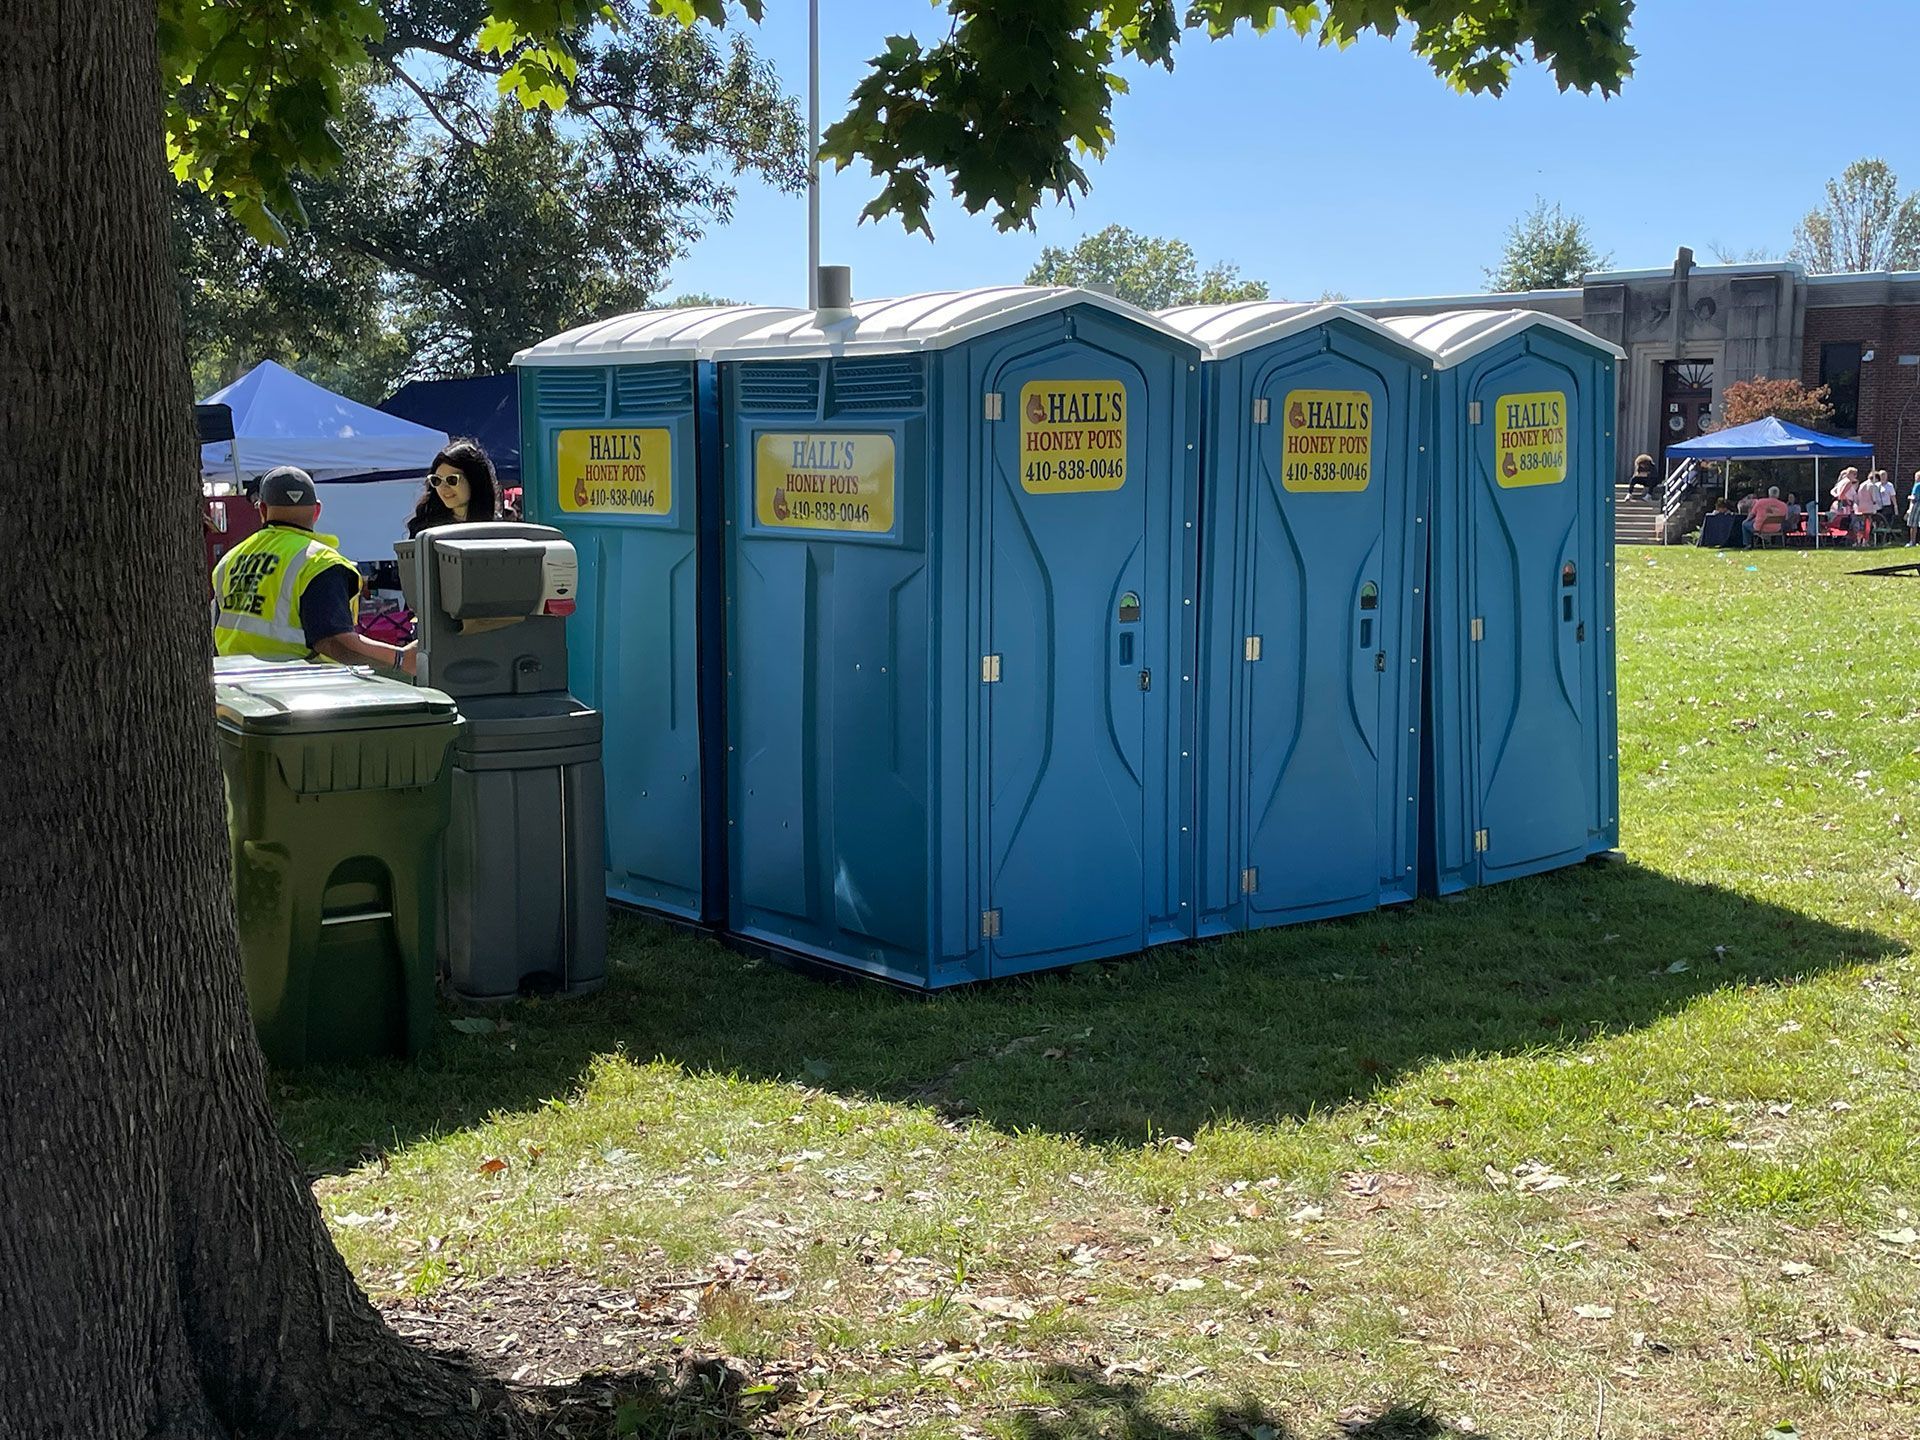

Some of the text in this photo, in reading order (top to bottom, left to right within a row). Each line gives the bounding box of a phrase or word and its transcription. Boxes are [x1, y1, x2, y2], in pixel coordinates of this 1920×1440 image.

[1048, 393, 1122, 423] HALL'S
[1307, 402, 1368, 429] HALL'S
[1507, 402, 1559, 429] HALL'S
[590, 435, 641, 460] HALL'S
[1026, 430, 1122, 451] HONEY POTS
[1288, 436, 1367, 454] HONEY POTS
[1502, 427, 1563, 448] HONEY POTS
[792, 441, 855, 470] HALL'S
[1520, 451, 1563, 470] 838-0046
[585, 465, 646, 481] HONEY POTS
[1025, 459, 1123, 481] 410-838-0046
[1287, 463, 1367, 480] 410-838-0046
[786, 474, 859, 495] HONEY POTS
[590, 489, 655, 506] 410-838-0046
[792, 501, 869, 523] 410-838-0046
